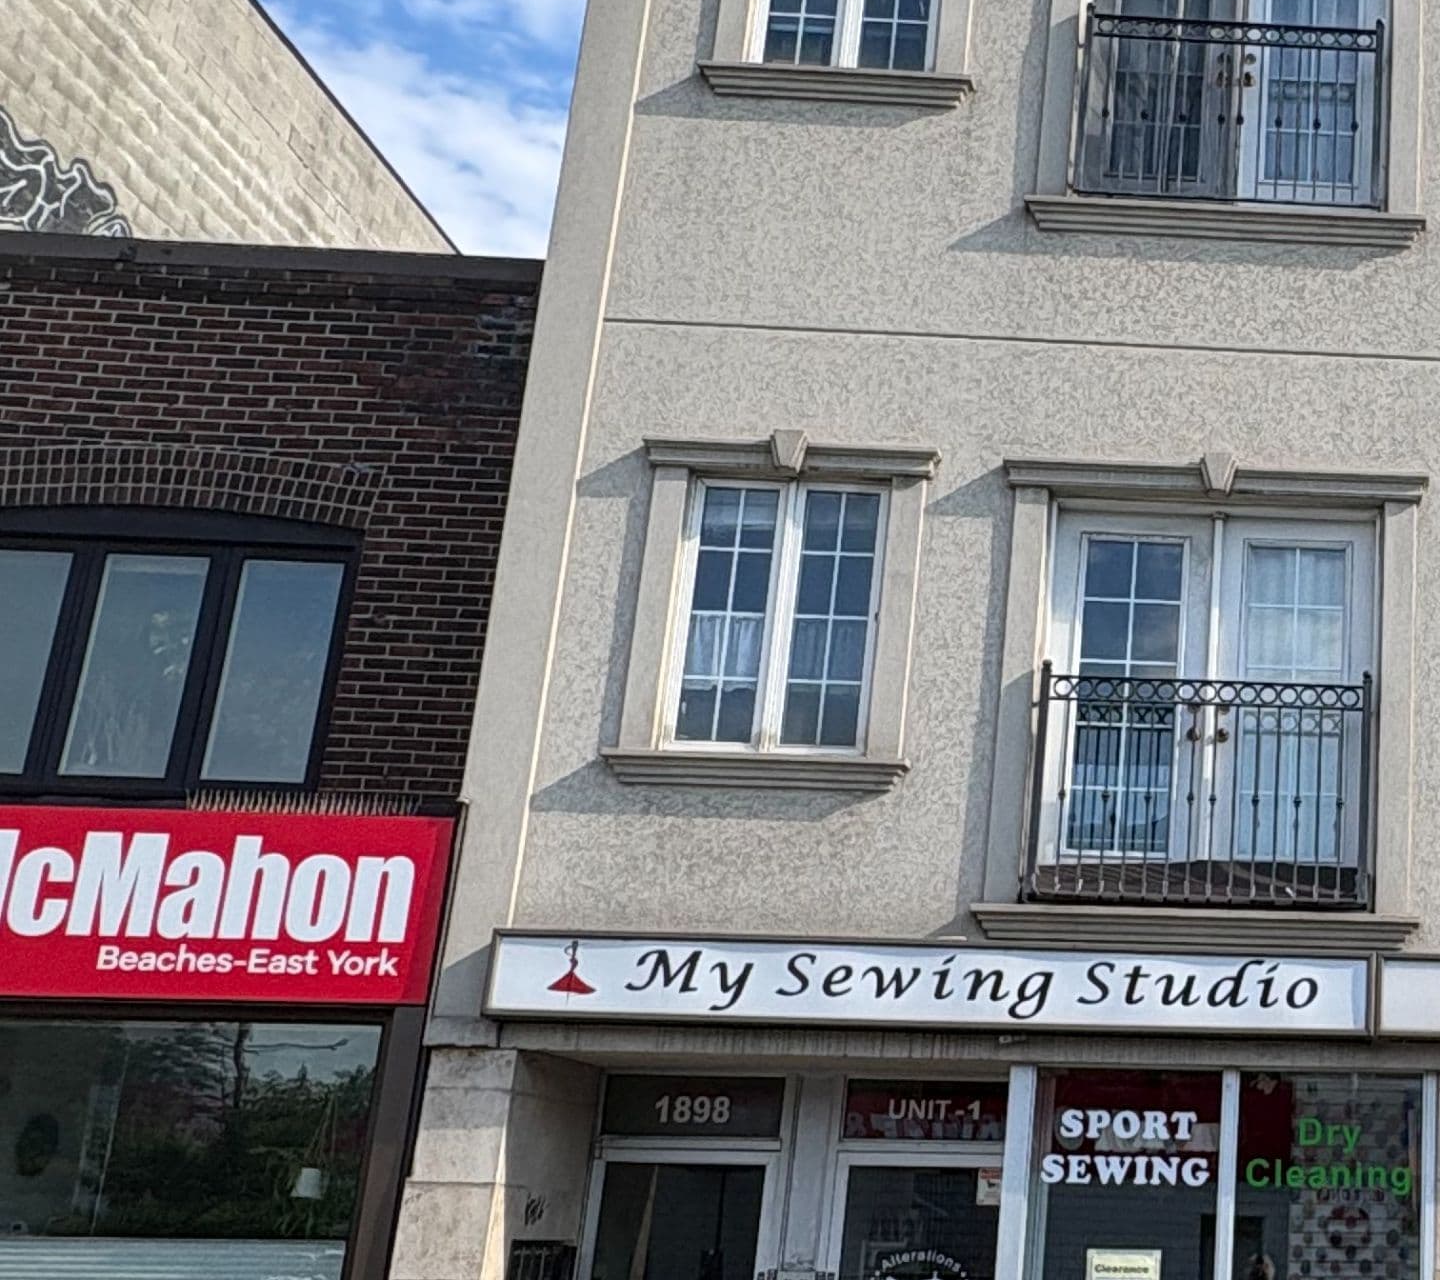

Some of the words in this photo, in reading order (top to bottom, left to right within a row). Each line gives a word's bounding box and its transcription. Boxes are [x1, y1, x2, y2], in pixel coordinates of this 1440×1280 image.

[96, 944, 318, 975] Beaches-East
[327, 949, 398, 977] York
[625, 949, 754, 1011] My
[775, 953, 1055, 1019] Sewing
[1077, 959, 1319, 1009] Studio
[655, 1095, 731, 1124] 1898
[1060, 1108, 1198, 1141] SPORT
[1300, 1118, 1361, 1156] Dry
[1041, 1155, 1211, 1187] SEWING
[1245, 1158, 1413, 1197] Cleaning
[881, 1249, 962, 1273] Alterations
